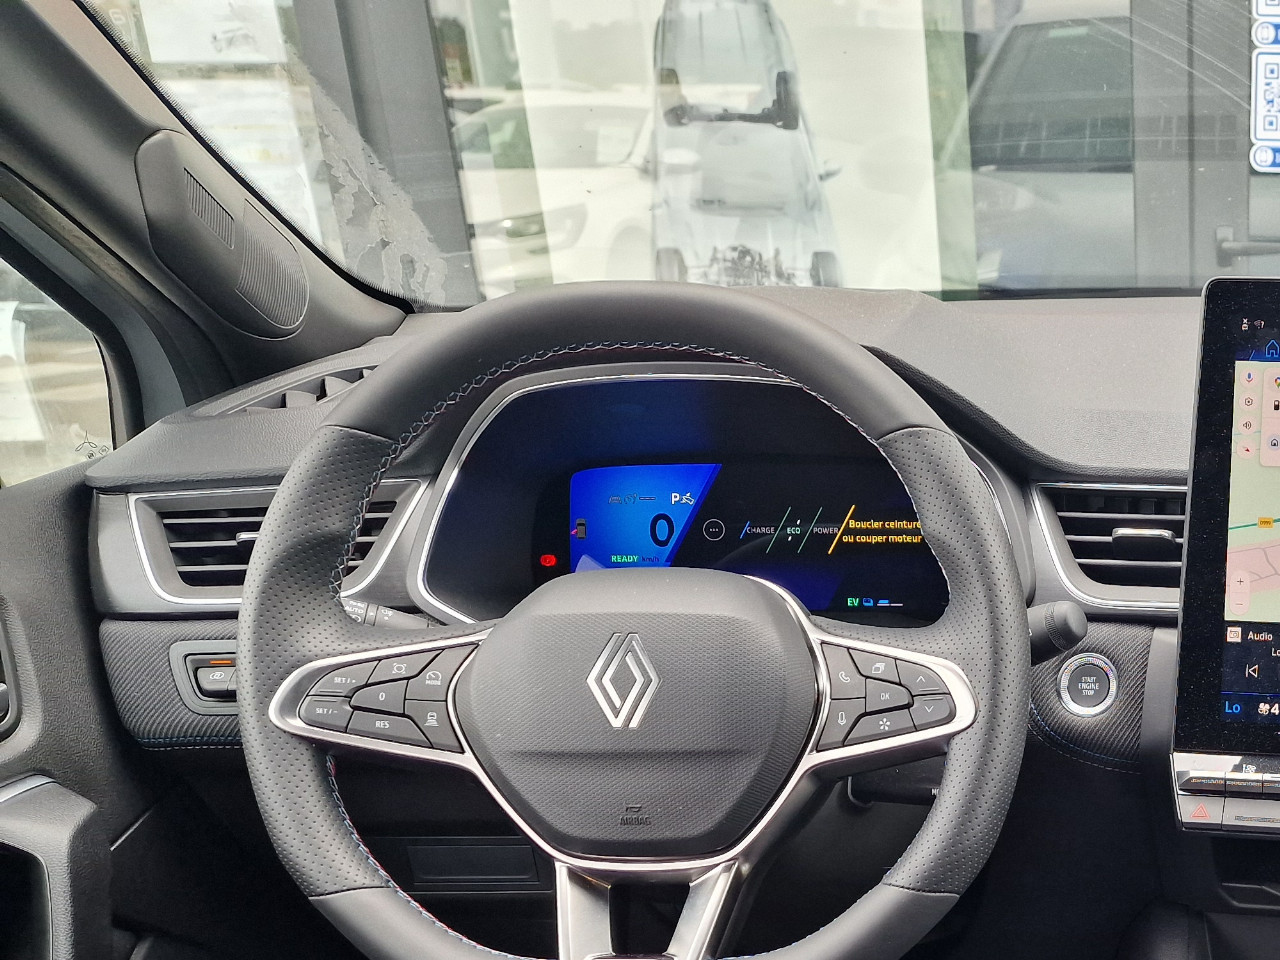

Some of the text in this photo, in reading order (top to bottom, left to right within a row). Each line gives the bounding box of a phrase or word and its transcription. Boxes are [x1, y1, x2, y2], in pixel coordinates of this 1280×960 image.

[671, 493, 680, 504] P
[849, 519, 883, 529] Boucler
[650, 513, 675, 547] 0
[746, 526, 775, 534] CHARGE
[842, 534, 922, 544] ou couper moteur
[611, 555, 639, 563] READY
[847, 597, 859, 606] EV
[1247, 631, 1273, 641] Audio
[334, 676, 347, 684] SET
[1078, 682, 1100, 690] ENGINE
[880, 692, 890, 700] OK
[1225, 701, 1241, 713] Lo
[1270, 703, 1279, 715] 4
